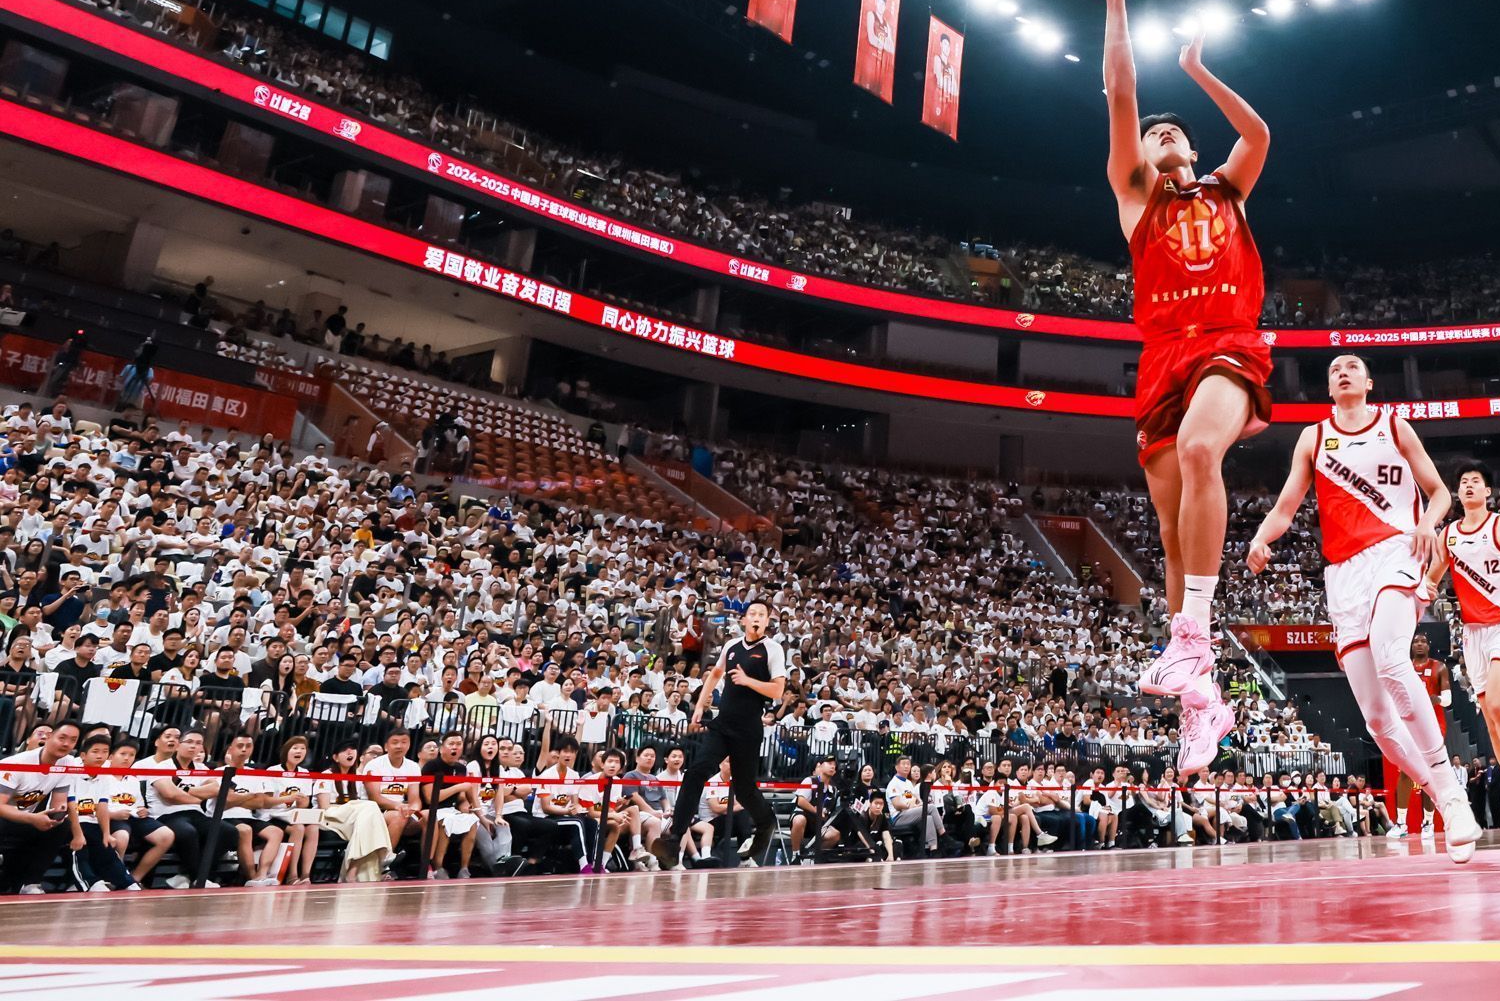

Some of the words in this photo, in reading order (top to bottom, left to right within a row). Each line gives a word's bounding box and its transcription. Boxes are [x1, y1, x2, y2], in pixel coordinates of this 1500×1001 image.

[1179, 220, 1211, 250] 11
[424, 245, 573, 315] 爱国敬业奋发图强
[601, 305, 737, 359] 同心协力振兴篮球
[1324, 452, 1393, 512] JIANGSU
[1377, 465, 1403, 486] 50
[1484, 560, 1500, 575] 12
